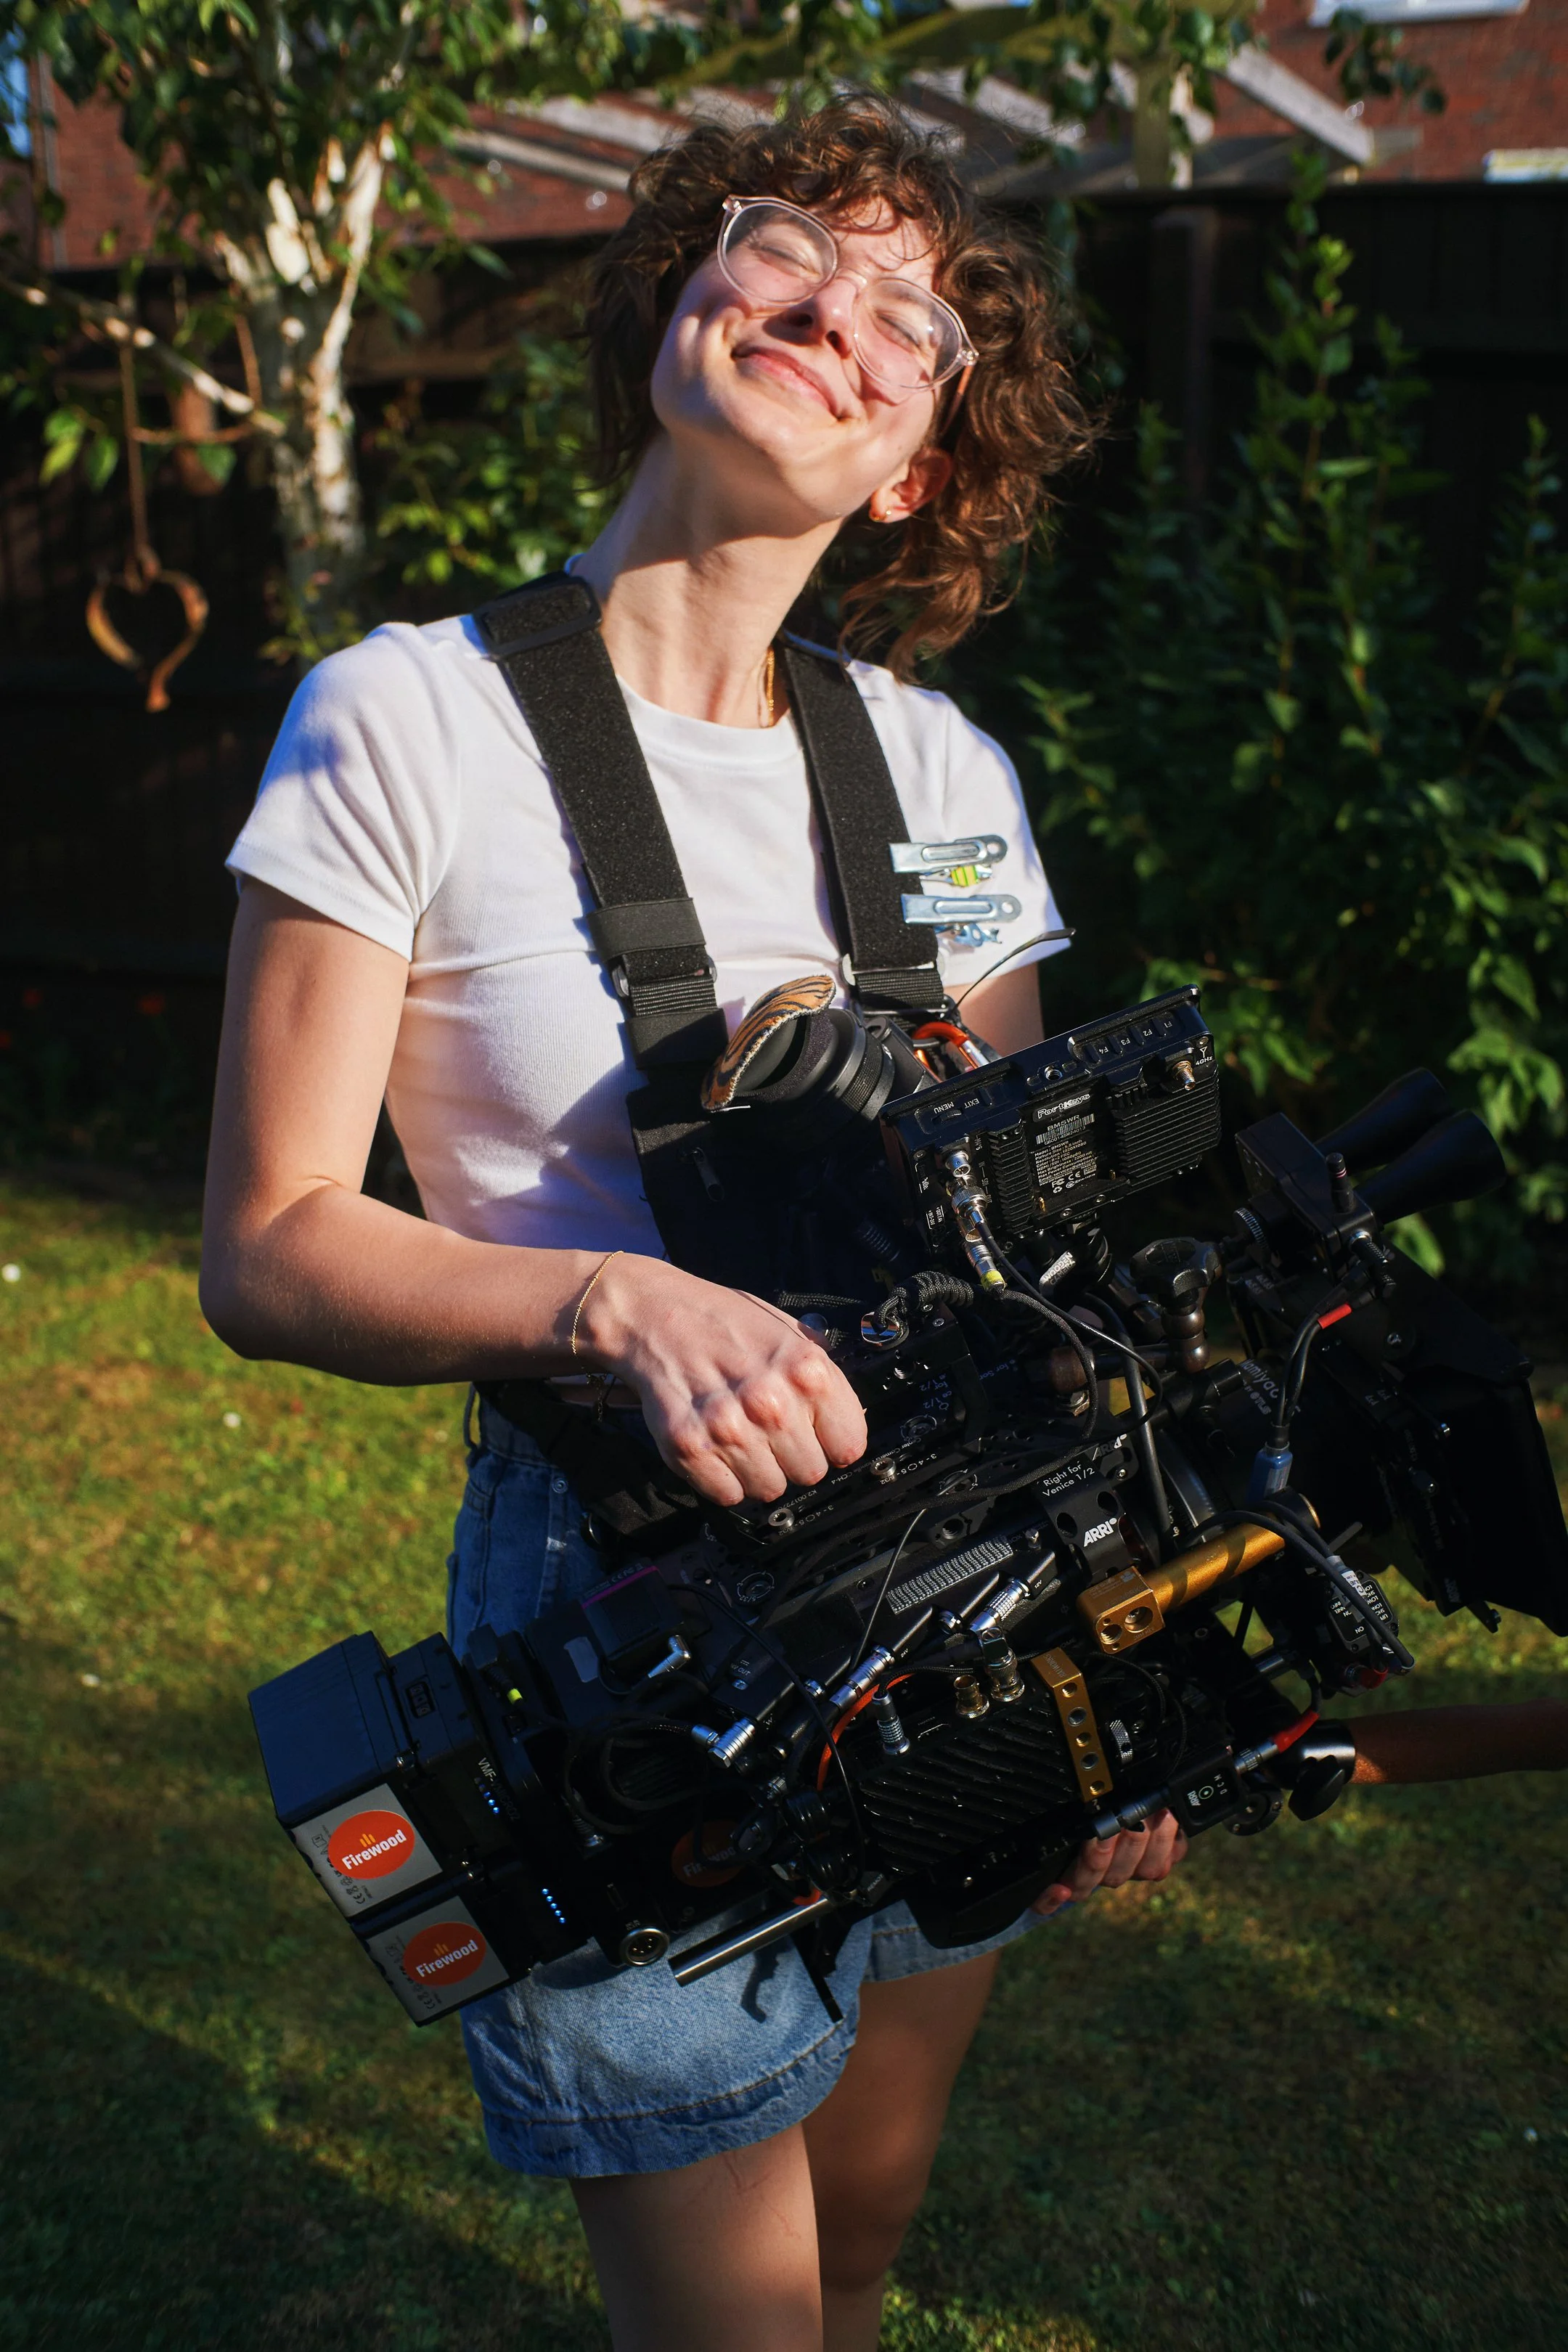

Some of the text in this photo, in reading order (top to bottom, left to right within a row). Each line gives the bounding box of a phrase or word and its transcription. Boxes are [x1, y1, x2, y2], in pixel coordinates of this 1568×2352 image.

[1098, 1046, 1109, 1055] F4
[1120, 1037, 1131, 1046] F3
[934, 1101, 955, 1114] MENU
[964, 1098, 980, 1109] EXIT
[1042, 1462, 1082, 1487] Right for
[1042, 1467, 1095, 1497] Venice 1/2
[1084, 1519, 1116, 1548] ARRI
[341, 1829, 407, 1871] Firewood
[415, 1940, 479, 1978] Firewood
